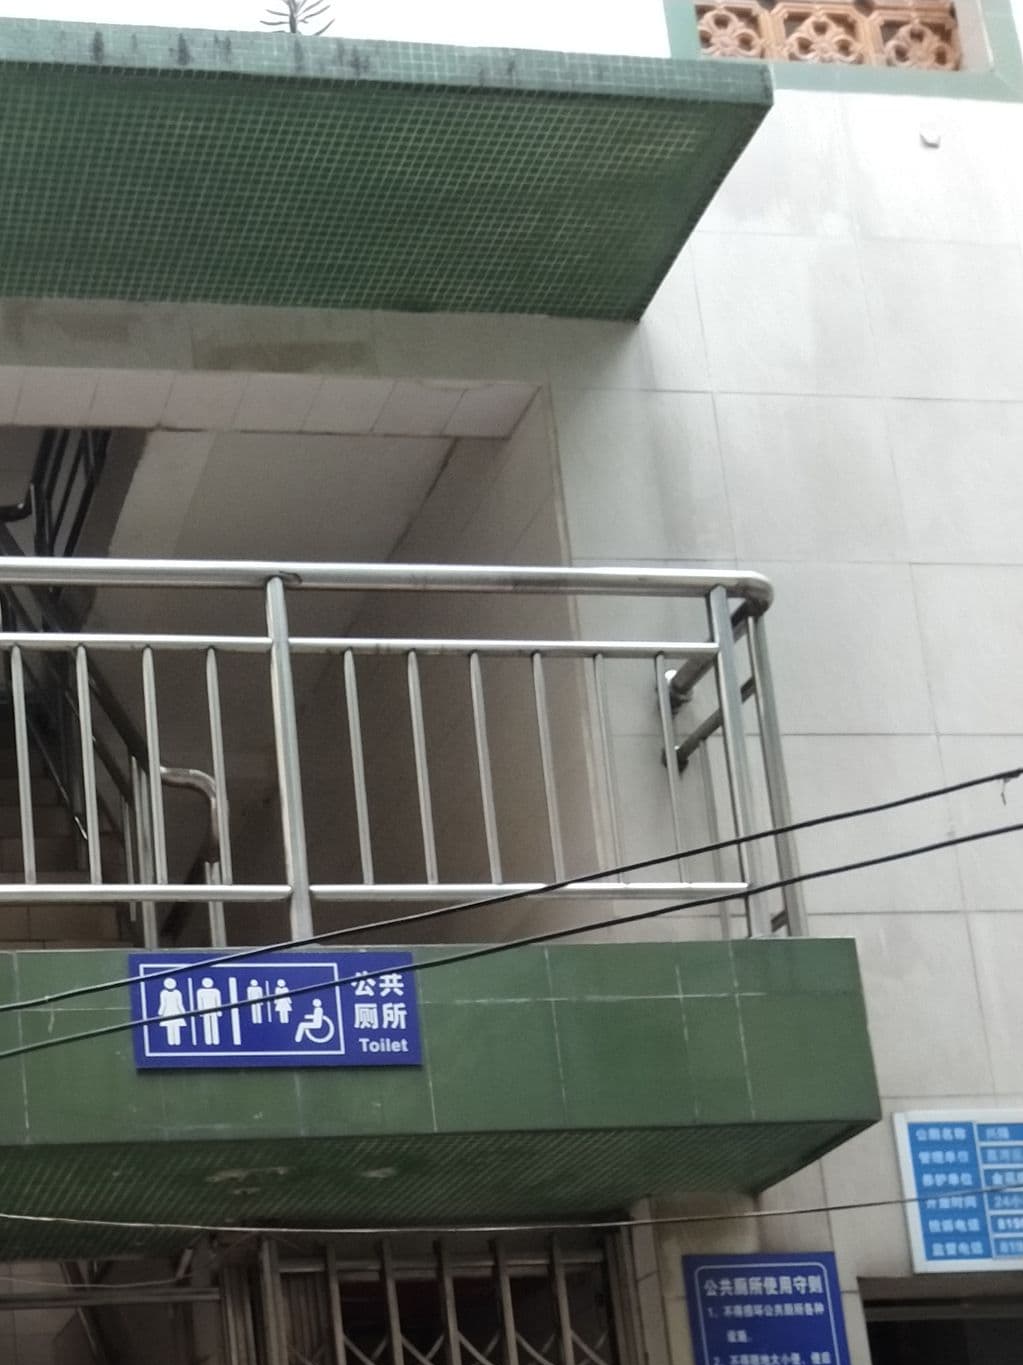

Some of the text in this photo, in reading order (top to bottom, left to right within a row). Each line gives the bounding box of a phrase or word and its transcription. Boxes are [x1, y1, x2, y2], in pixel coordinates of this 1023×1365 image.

[351, 971, 405, 997] 公共
[354, 1002, 407, 1030] 厕所
[359, 1037, 409, 1053] Toilet
[703, 1275, 824, 1297] 公共厕所使用守则
